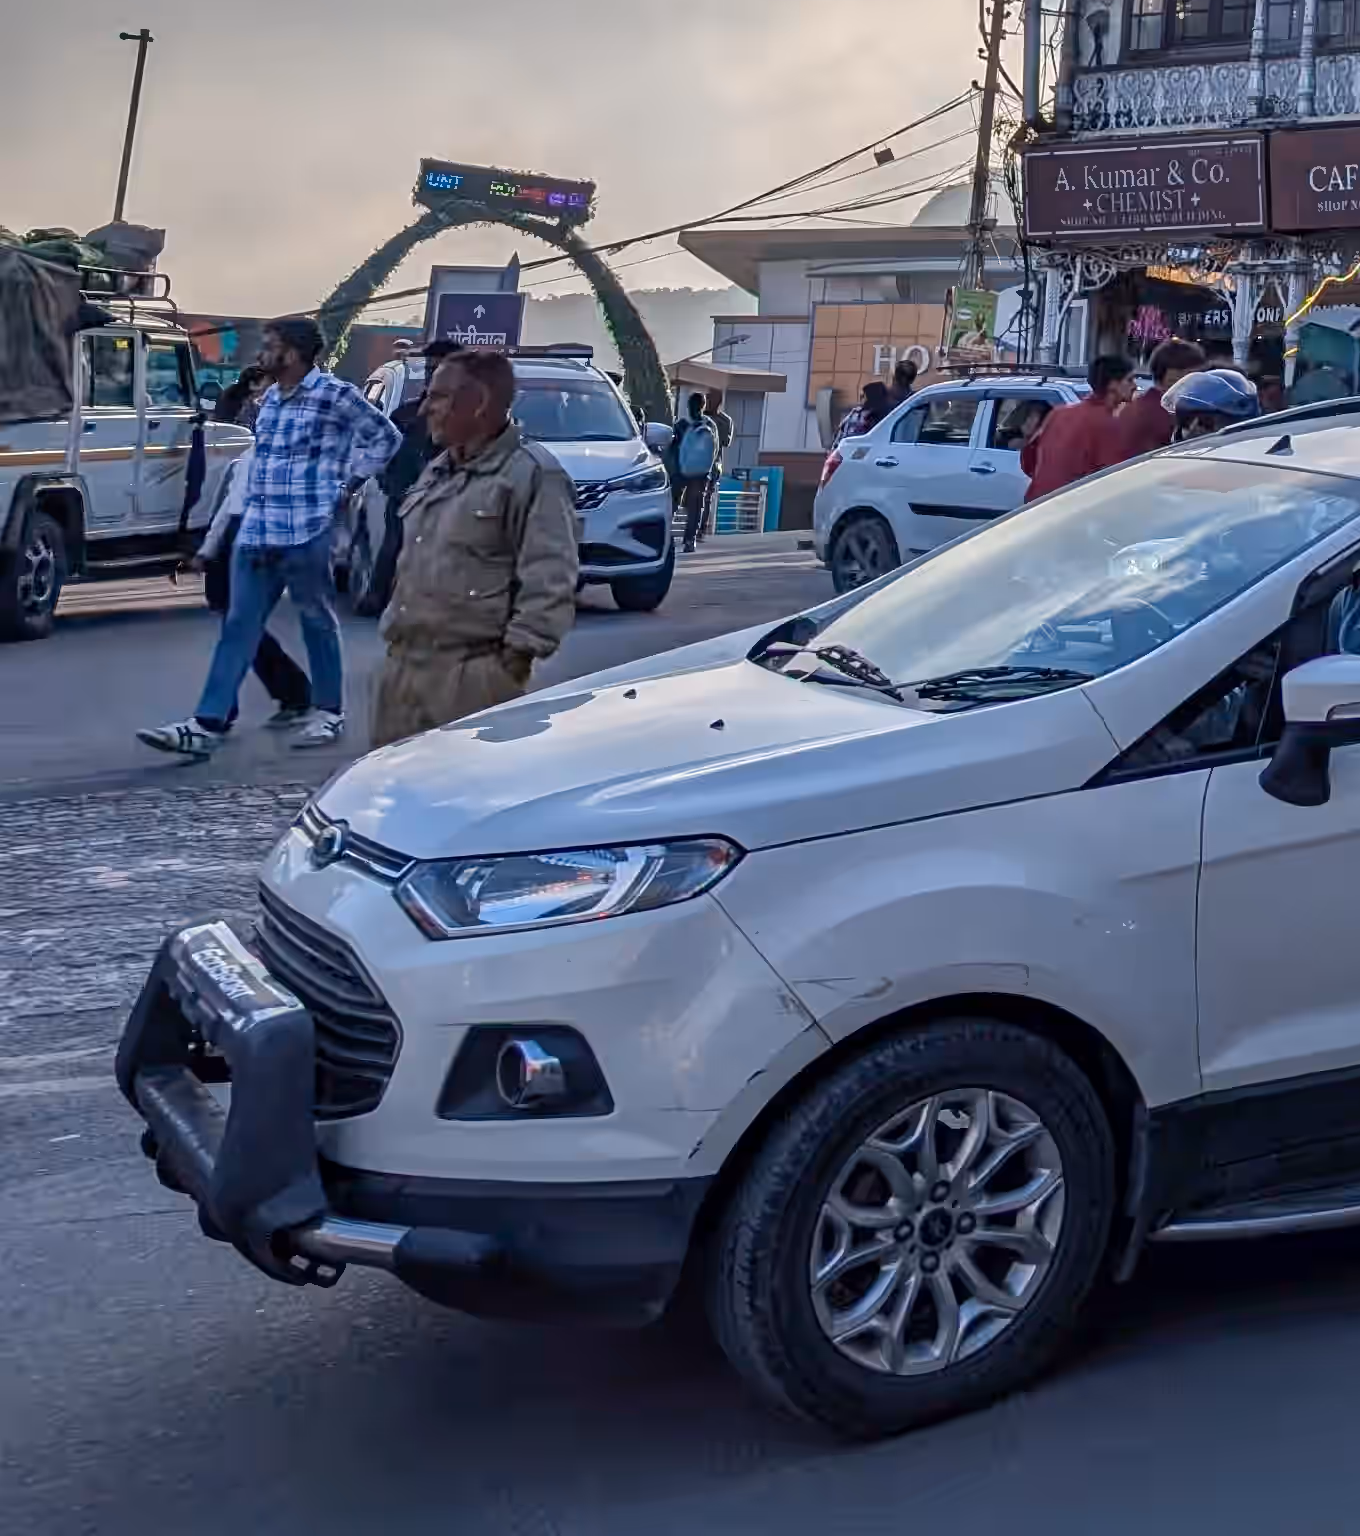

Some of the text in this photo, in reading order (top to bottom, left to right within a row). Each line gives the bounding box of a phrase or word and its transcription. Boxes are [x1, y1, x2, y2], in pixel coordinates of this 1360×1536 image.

[1055, 158, 1230, 191] A. Kumar & Co.
[1097, 189, 1185, 213] CHEMIST
[1317, 198, 1347, 212] SHOP
